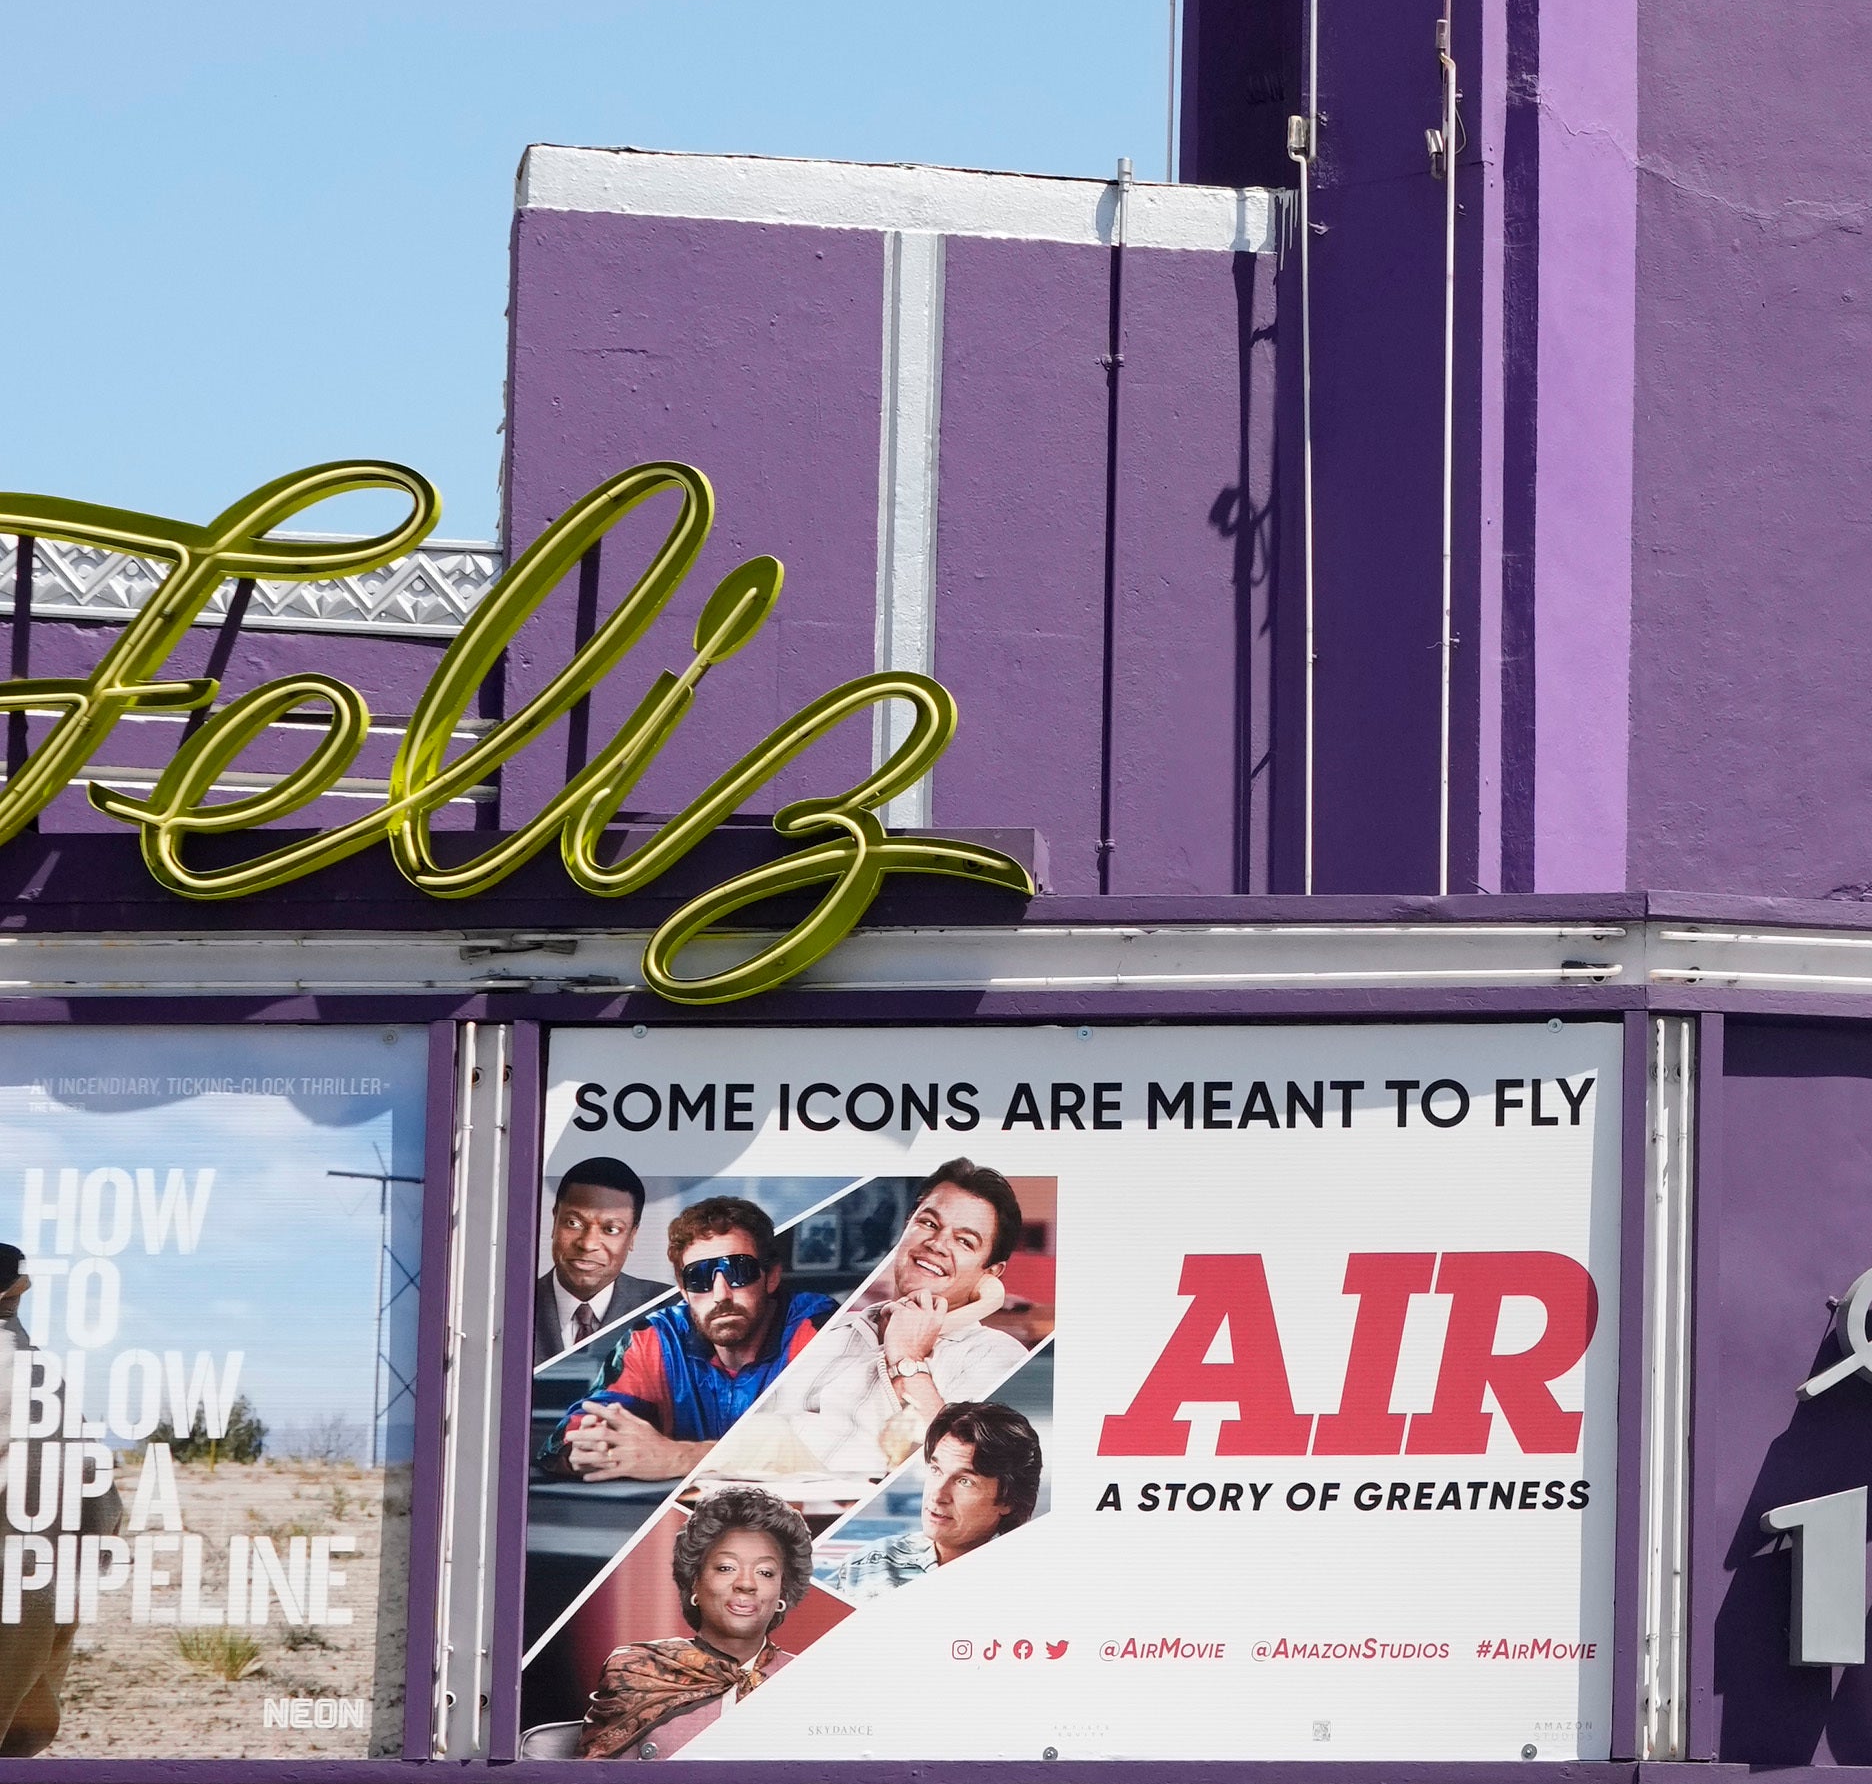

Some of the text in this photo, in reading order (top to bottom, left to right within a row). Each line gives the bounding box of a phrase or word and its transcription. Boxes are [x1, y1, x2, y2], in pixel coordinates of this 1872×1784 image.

[167, 1077, 294, 1095] TICKING-CLOCK
[573, 1077, 1598, 1134] SOME ICONS ARE MEANT TO FLY
[22, 1166, 217, 1256] HOW
[18, 1257, 120, 1348] TO
[9, 1349, 245, 1440] BLOW
[1096, 1249, 1597, 1458] AIR
[6, 1441, 183, 1533] UP A
[1096, 1480, 1592, 1513] A STORY OF GREATNESS
[1, 1535, 357, 1626] PIPELINE
[262, 1698, 364, 1729] NEON
[1534, 1721, 1593, 1731] AMAZON
